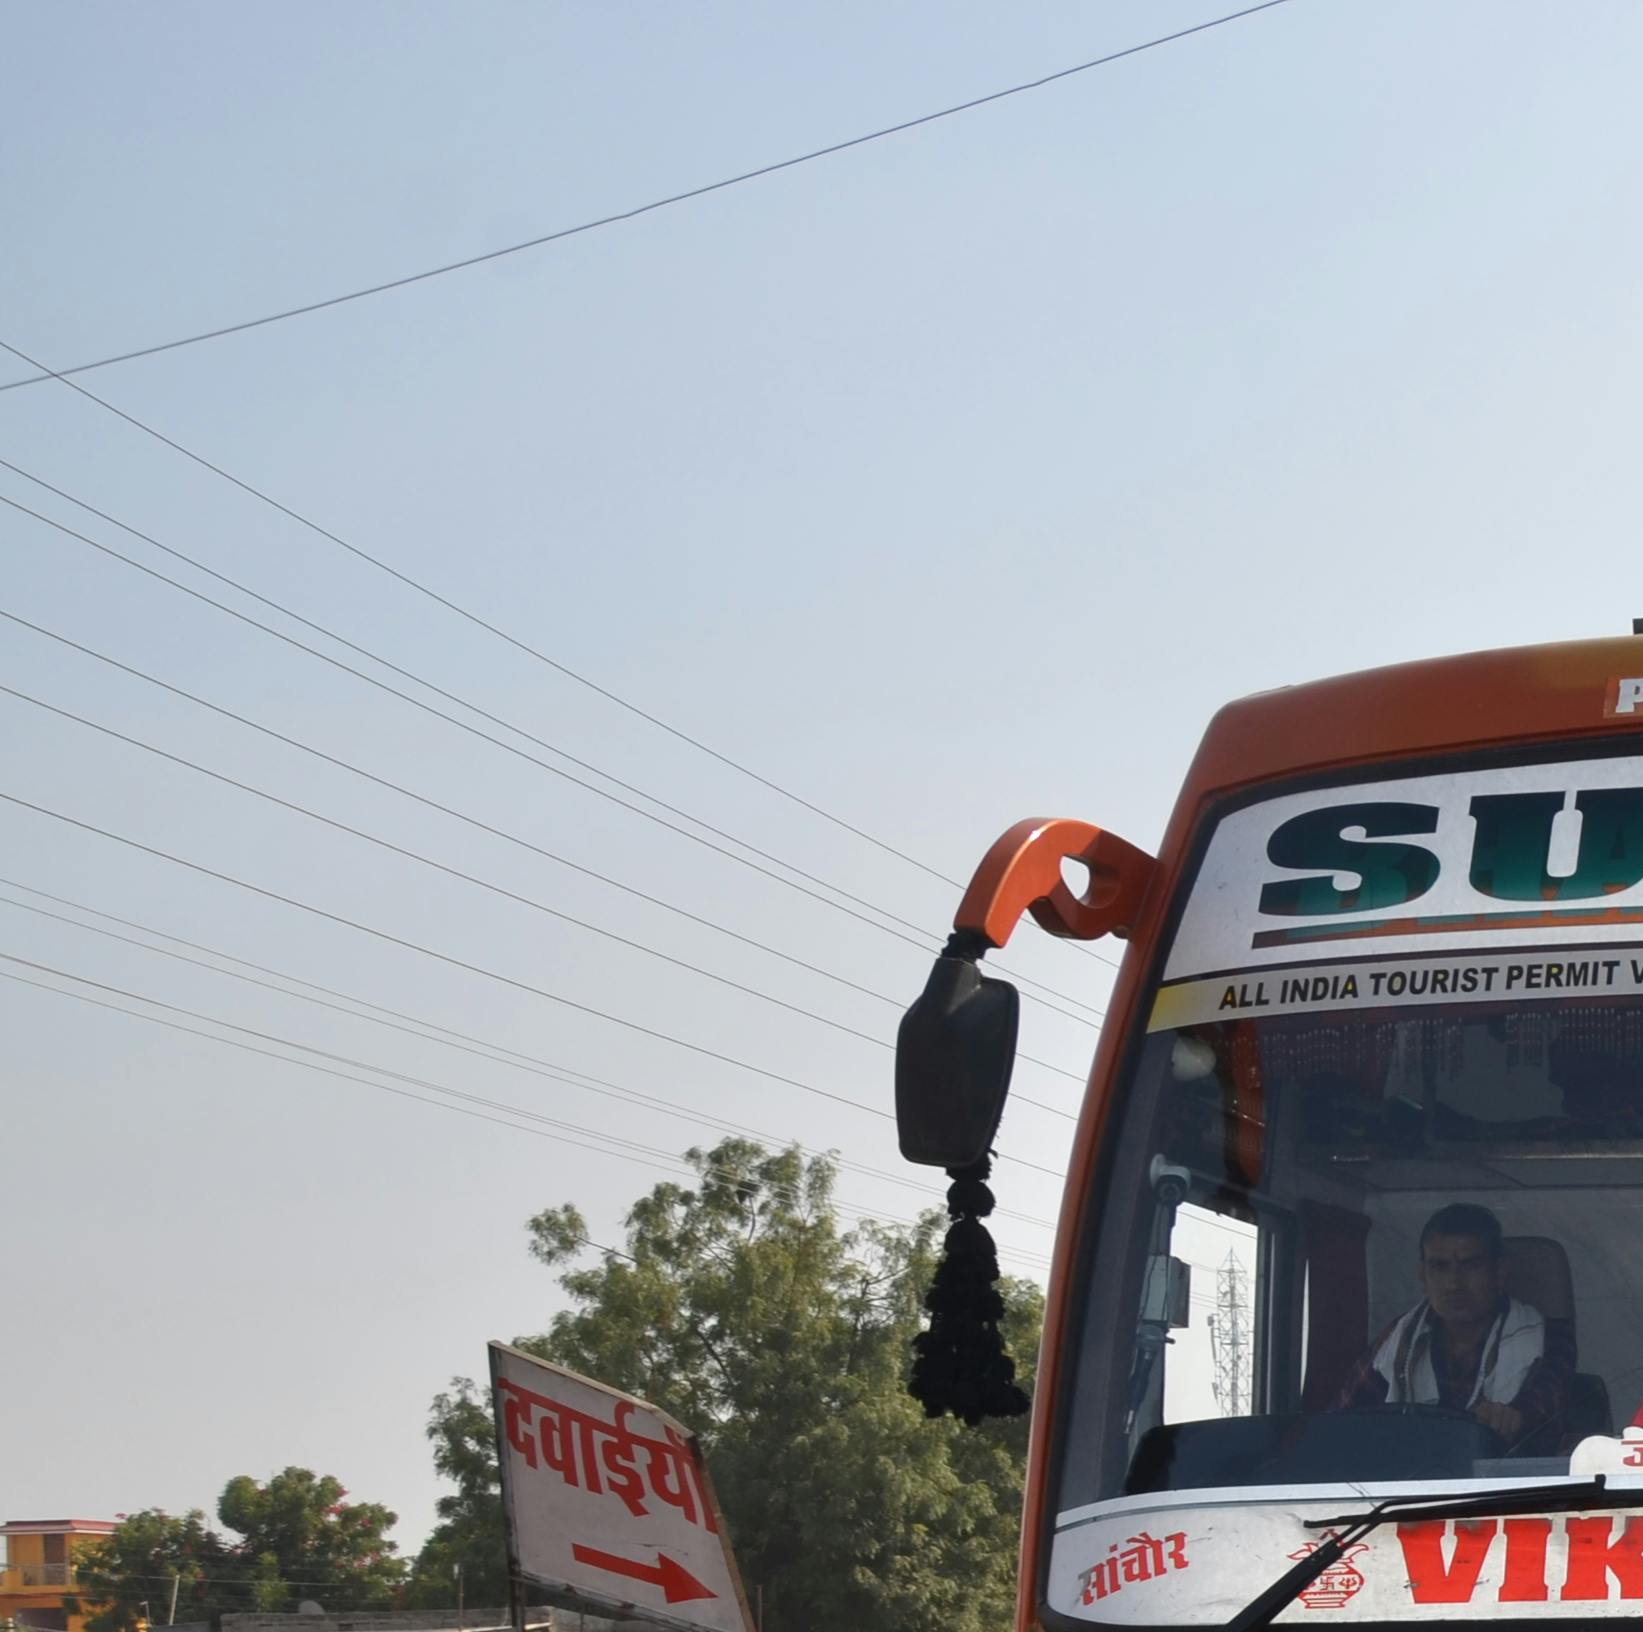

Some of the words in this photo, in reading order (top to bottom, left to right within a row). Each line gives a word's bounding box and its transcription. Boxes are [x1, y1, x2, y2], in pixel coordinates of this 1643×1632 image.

[1218, 985, 1270, 1011] ALL
[1280, 974, 1360, 1004] INDIA
[1369, 966, 1500, 997] TOURIST
[1505, 960, 1621, 990] PERMIT
[1078, 1531, 1189, 1606] सांचौर
